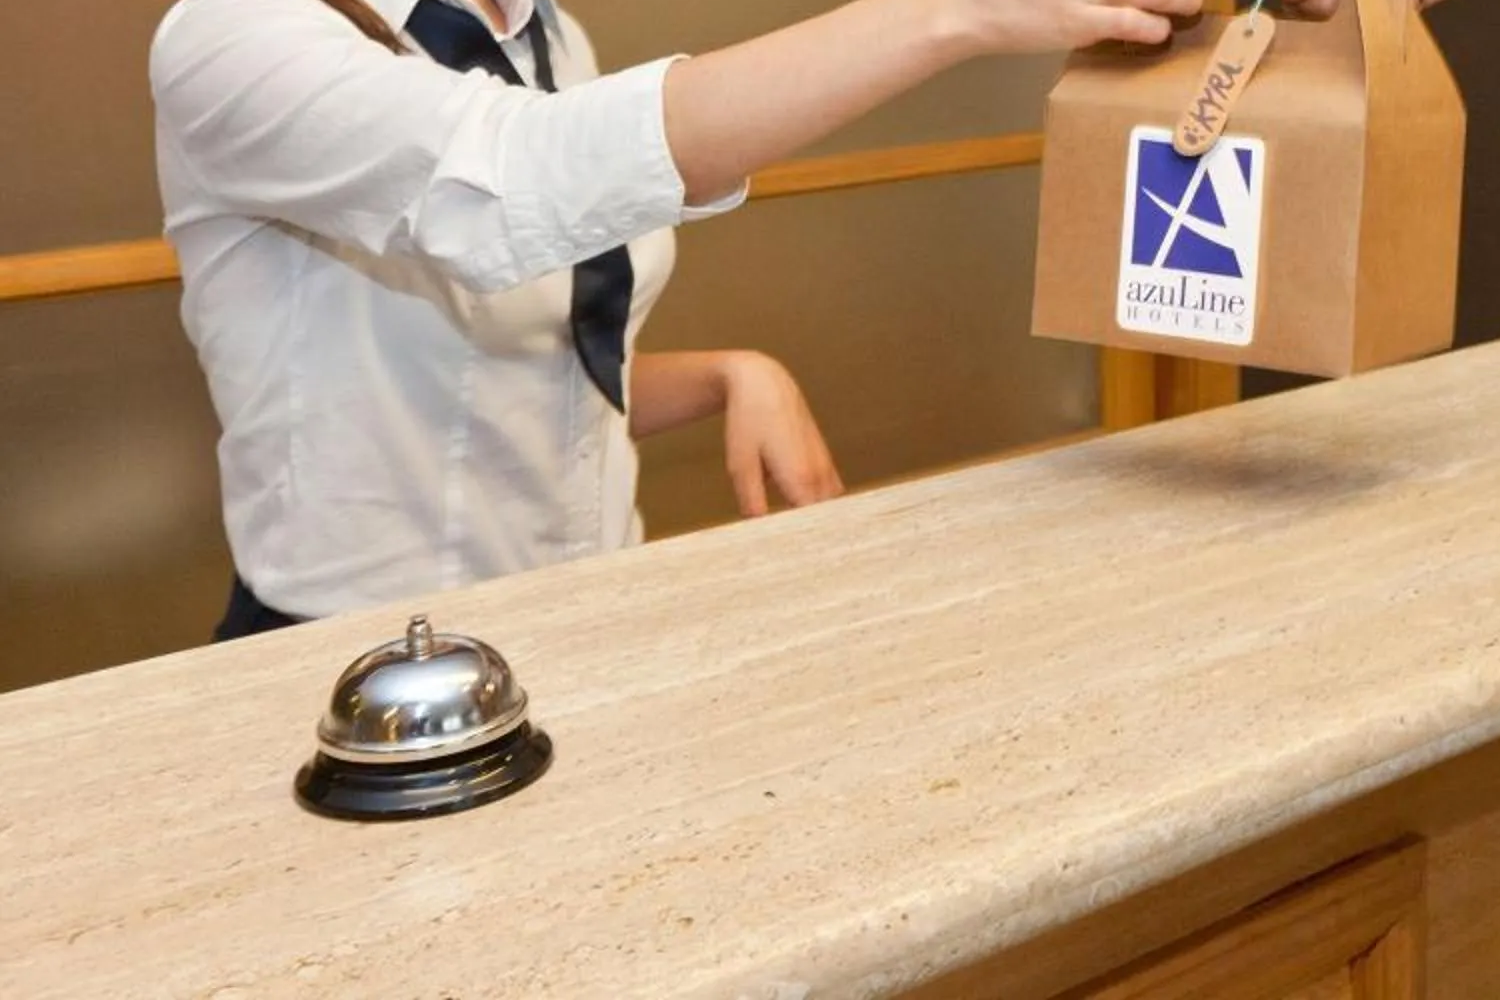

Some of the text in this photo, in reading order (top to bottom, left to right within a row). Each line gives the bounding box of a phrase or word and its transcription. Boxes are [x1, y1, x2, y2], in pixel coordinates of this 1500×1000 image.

[1188, 60, 1244, 133] KYRA
[1125, 275, 1246, 316] azuLine
[1126, 305, 1245, 335] HOTELS
